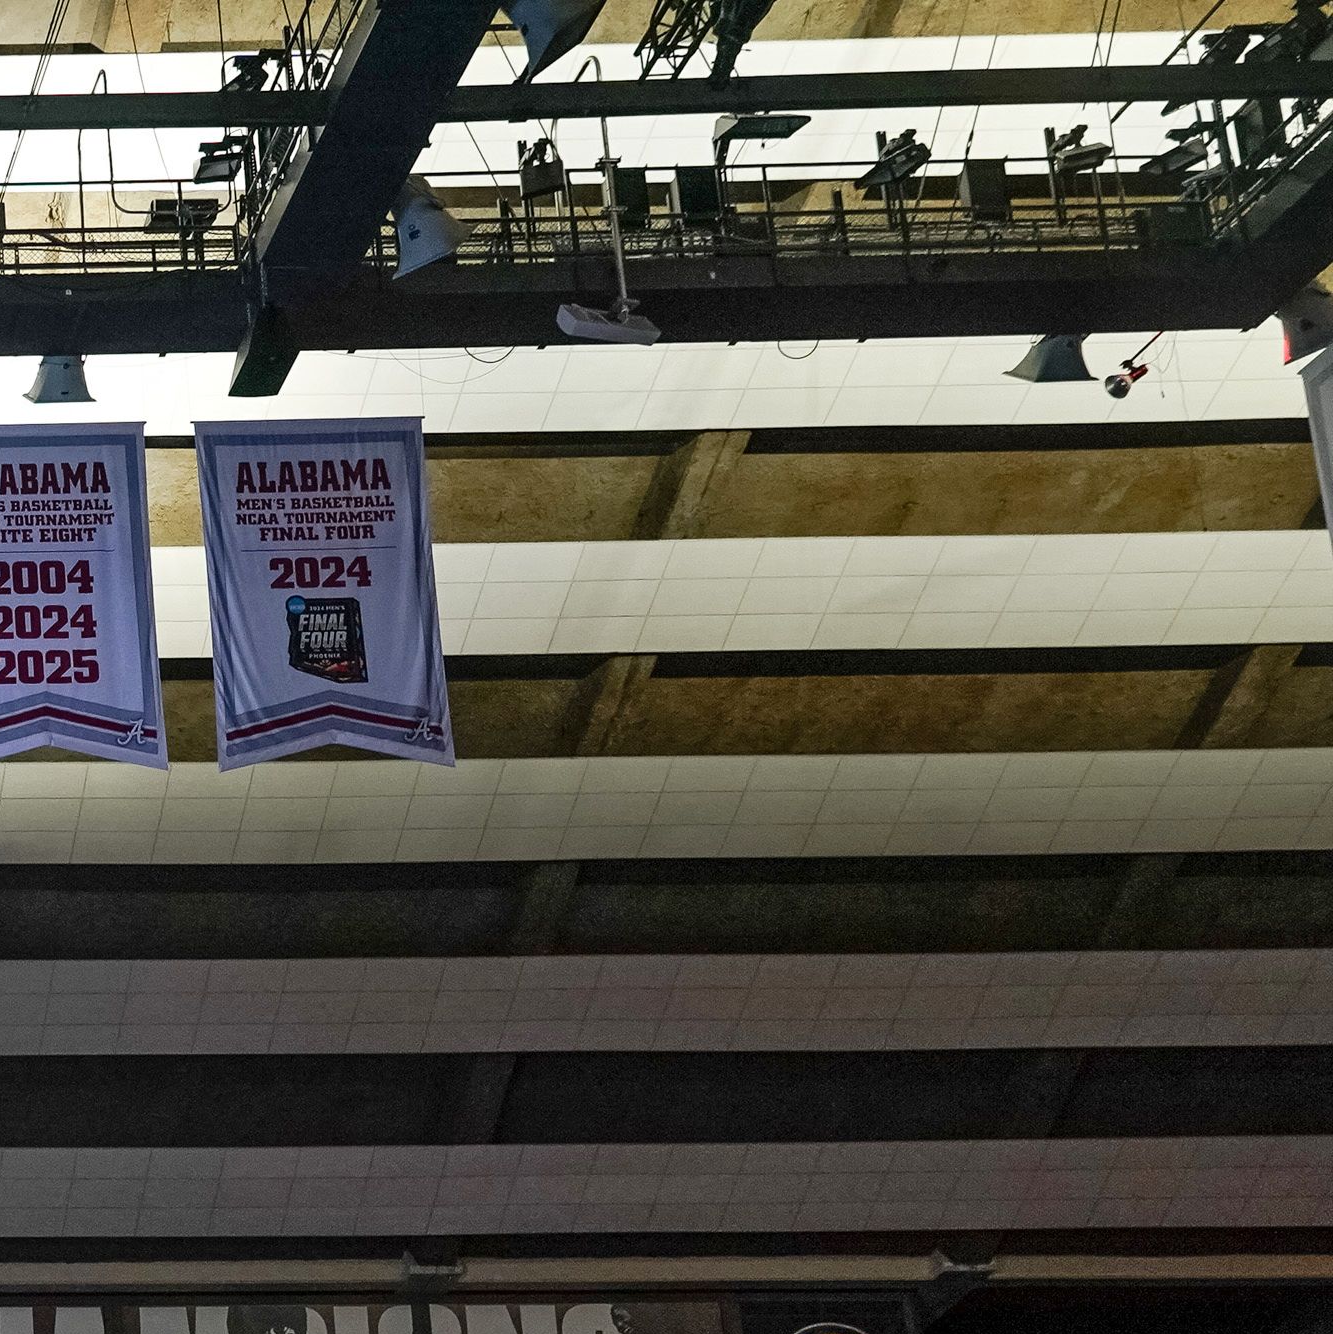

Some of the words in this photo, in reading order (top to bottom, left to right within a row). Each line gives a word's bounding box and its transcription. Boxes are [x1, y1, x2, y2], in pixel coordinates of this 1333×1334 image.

[236, 458, 391, 493] ALABAMA
[10, 499, 112, 512] BASKETBALL
[237, 498, 285, 510] MEN'S
[291, 496, 394, 510] BASKETBALL
[3, 513, 114, 527] TOURNAMENT
[236, 513, 279, 525] NCAA
[284, 510, 395, 524] TOURNAMENT
[39, 528, 96, 543] EIGHT
[259, 527, 319, 541] FINAL
[325, 525, 376, 540] FOUR
[269, 556, 372, 589] 2024
[298, 613, 347, 631] FINAL
[299, 631, 347, 649] FOUR
